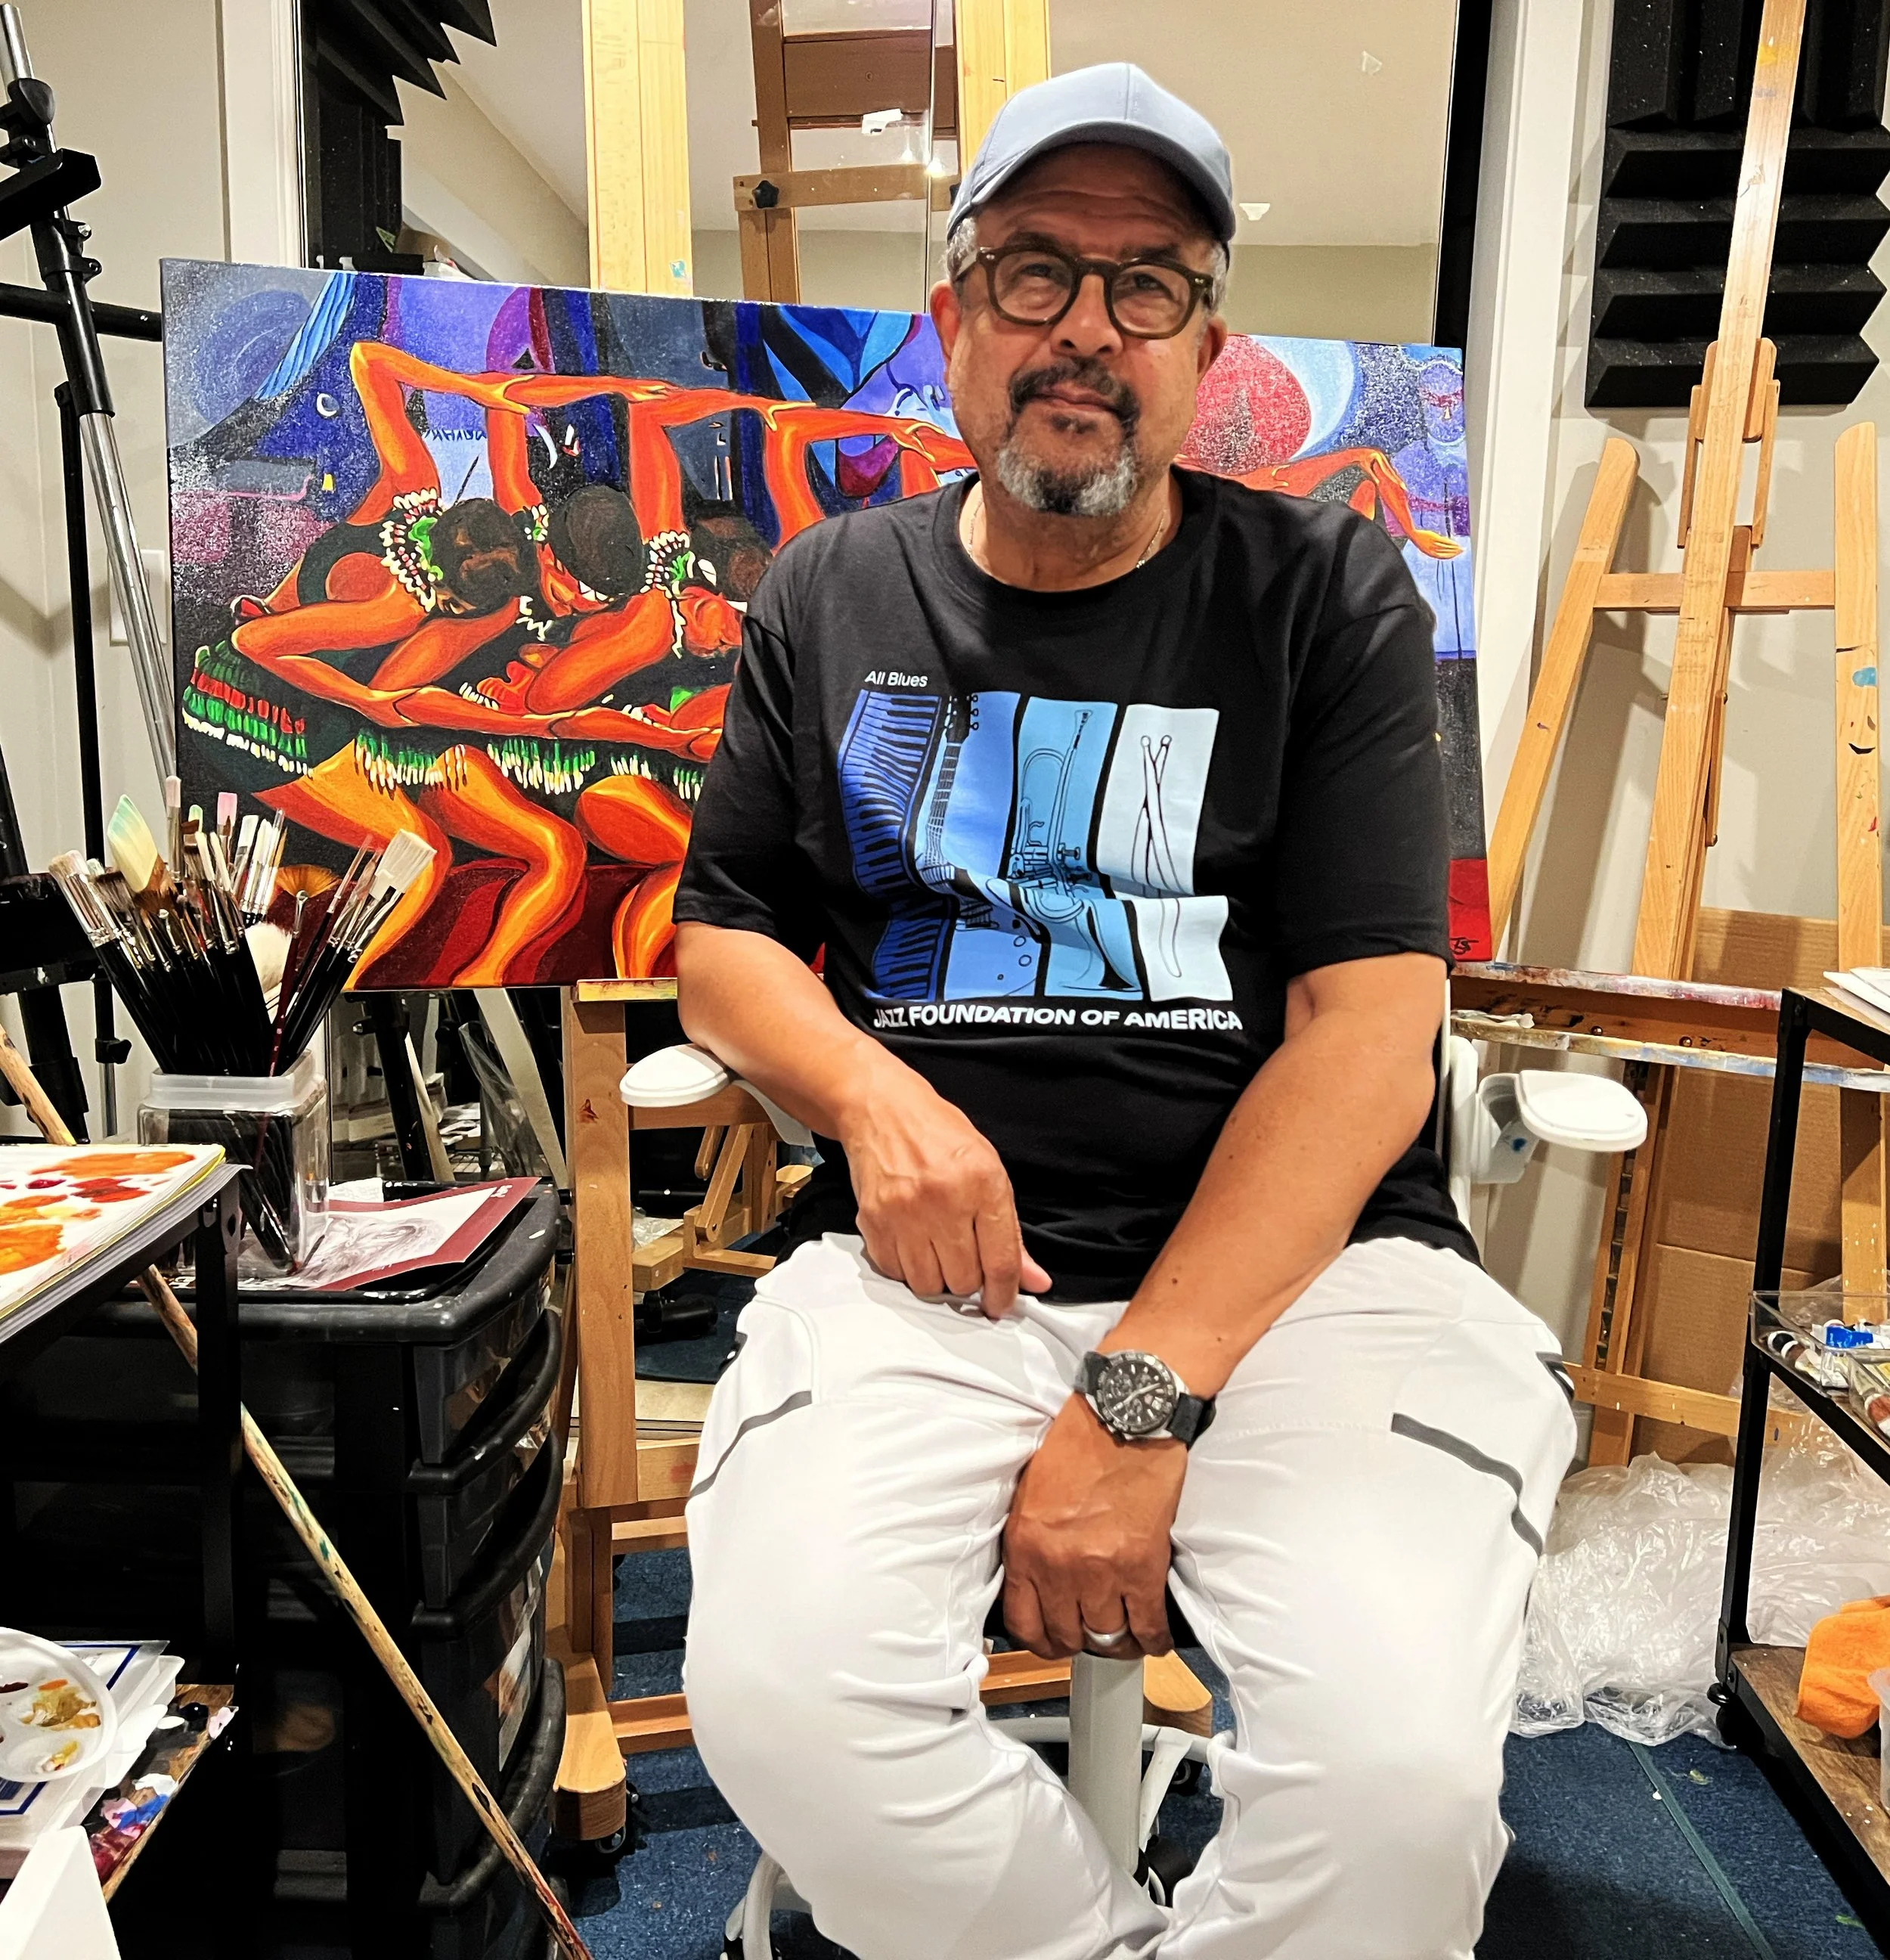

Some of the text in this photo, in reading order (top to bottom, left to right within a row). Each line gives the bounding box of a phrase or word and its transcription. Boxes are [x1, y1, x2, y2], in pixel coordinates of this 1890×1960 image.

[864, 670, 928, 687] All Blues
[873, 1004, 1244, 1030] JAZZ FOUNDATION OF AMERICA
